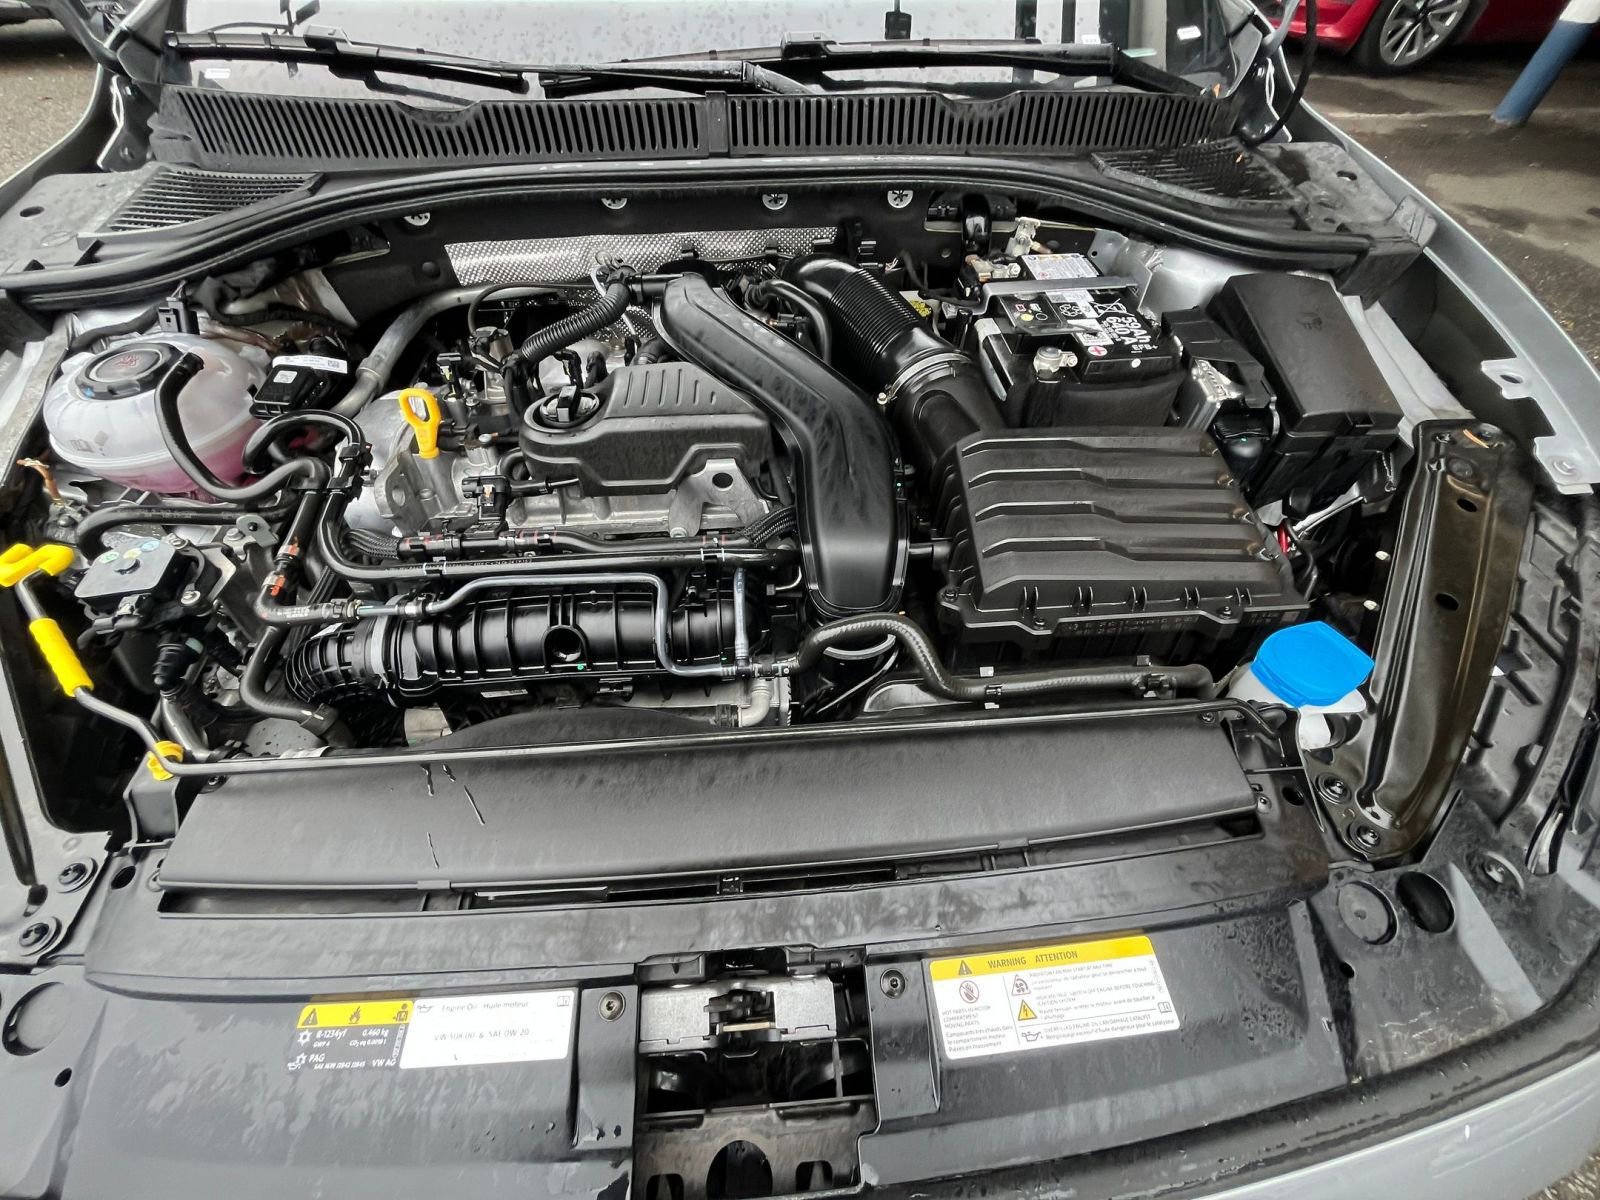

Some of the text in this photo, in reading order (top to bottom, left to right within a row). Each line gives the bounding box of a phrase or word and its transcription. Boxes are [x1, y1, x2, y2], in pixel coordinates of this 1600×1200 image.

[1106, 316, 1130, 335] 640
[1120, 336, 1138, 345] A
[1121, 316, 1152, 343] 59Ah
[987, 950, 1078, 969] WARNING ATTENTION
[315, 1028, 348, 1041] R-1234yf
[308, 1052, 326, 1063] PAG
[372, 1058, 385, 1067] VW
[385, 1058, 397, 1067] AG
